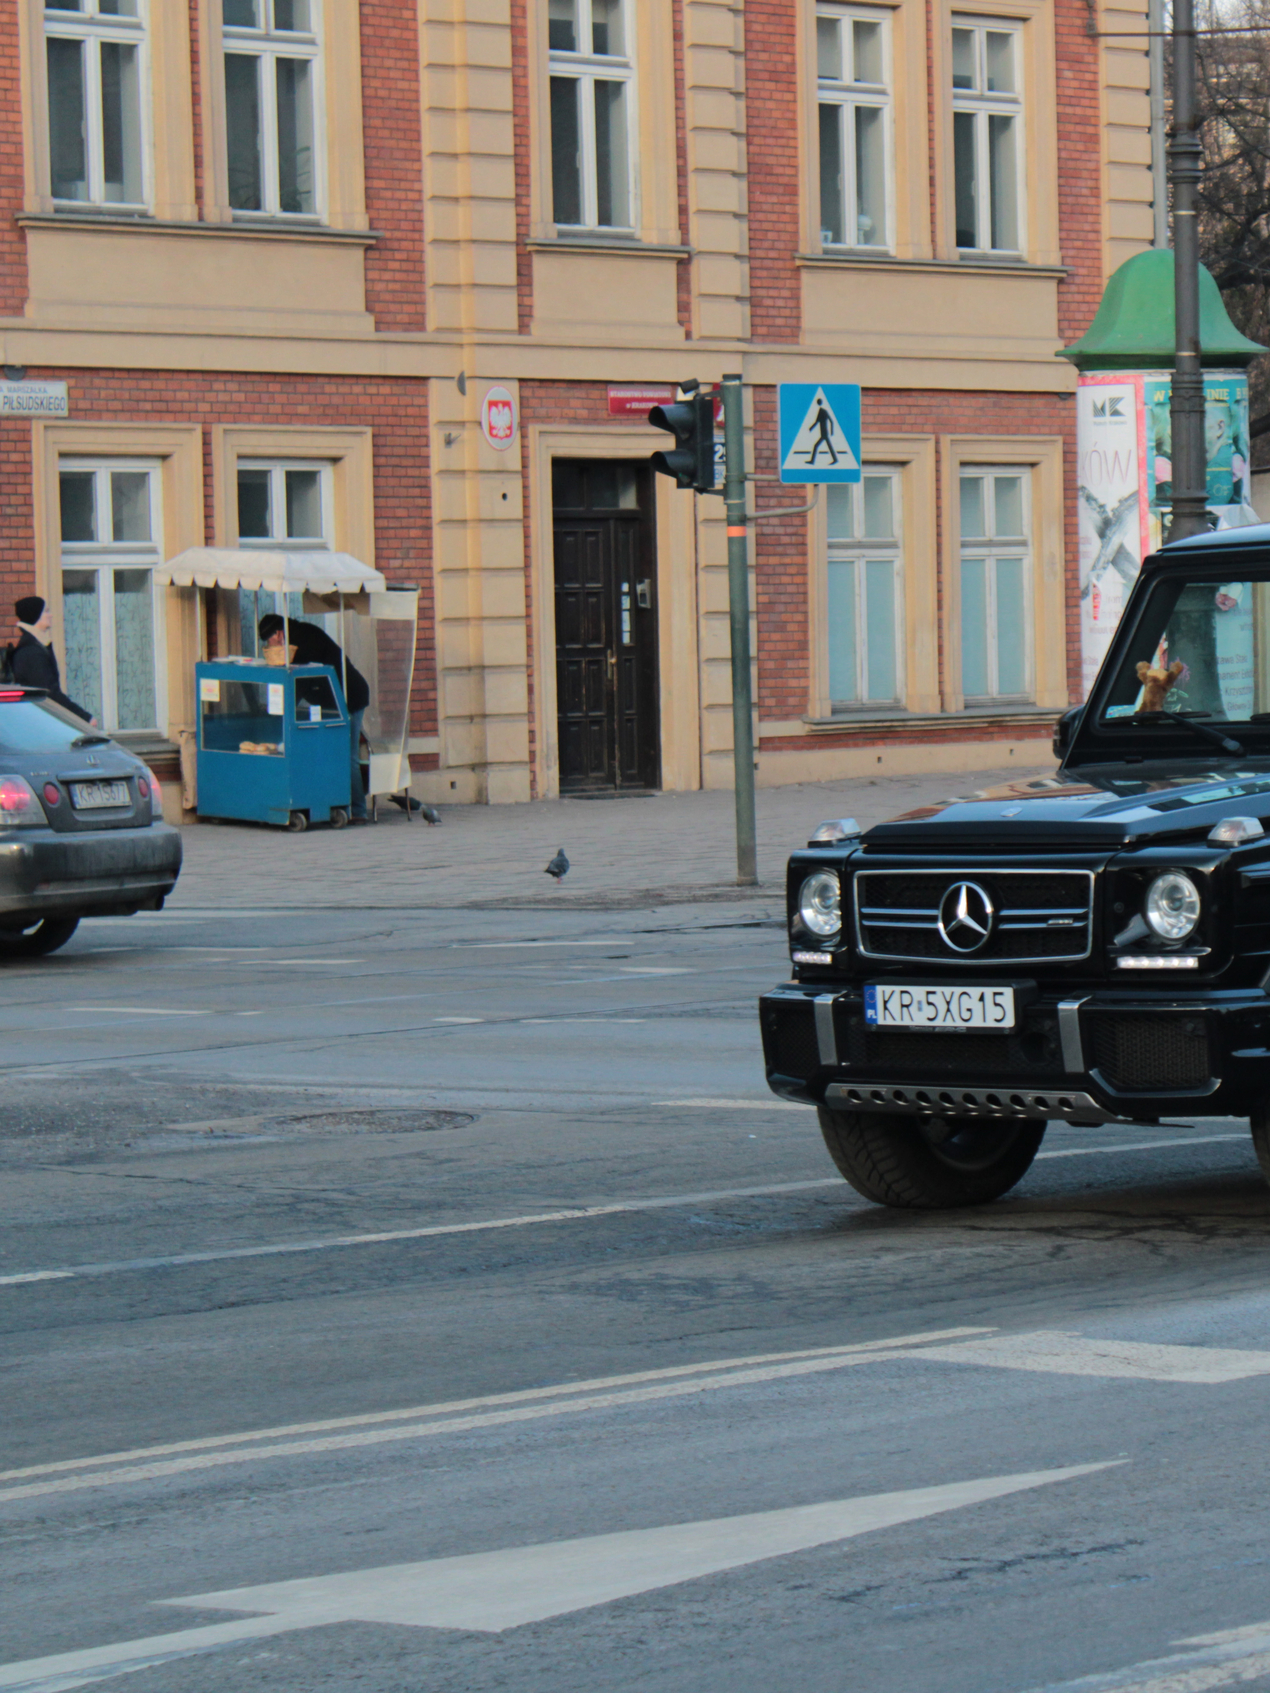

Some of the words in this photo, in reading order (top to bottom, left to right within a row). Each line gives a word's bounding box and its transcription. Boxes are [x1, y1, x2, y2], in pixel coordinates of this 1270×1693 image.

[3, 395, 66, 411] PIŁSUDSKIEGO
[714, 444, 727, 462] 2
[79, 784, 96, 802] KR
[867, 1009, 878, 1019] PL
[882, 989, 914, 1022] KR
[925, 990, 1007, 1023] 5XG15
